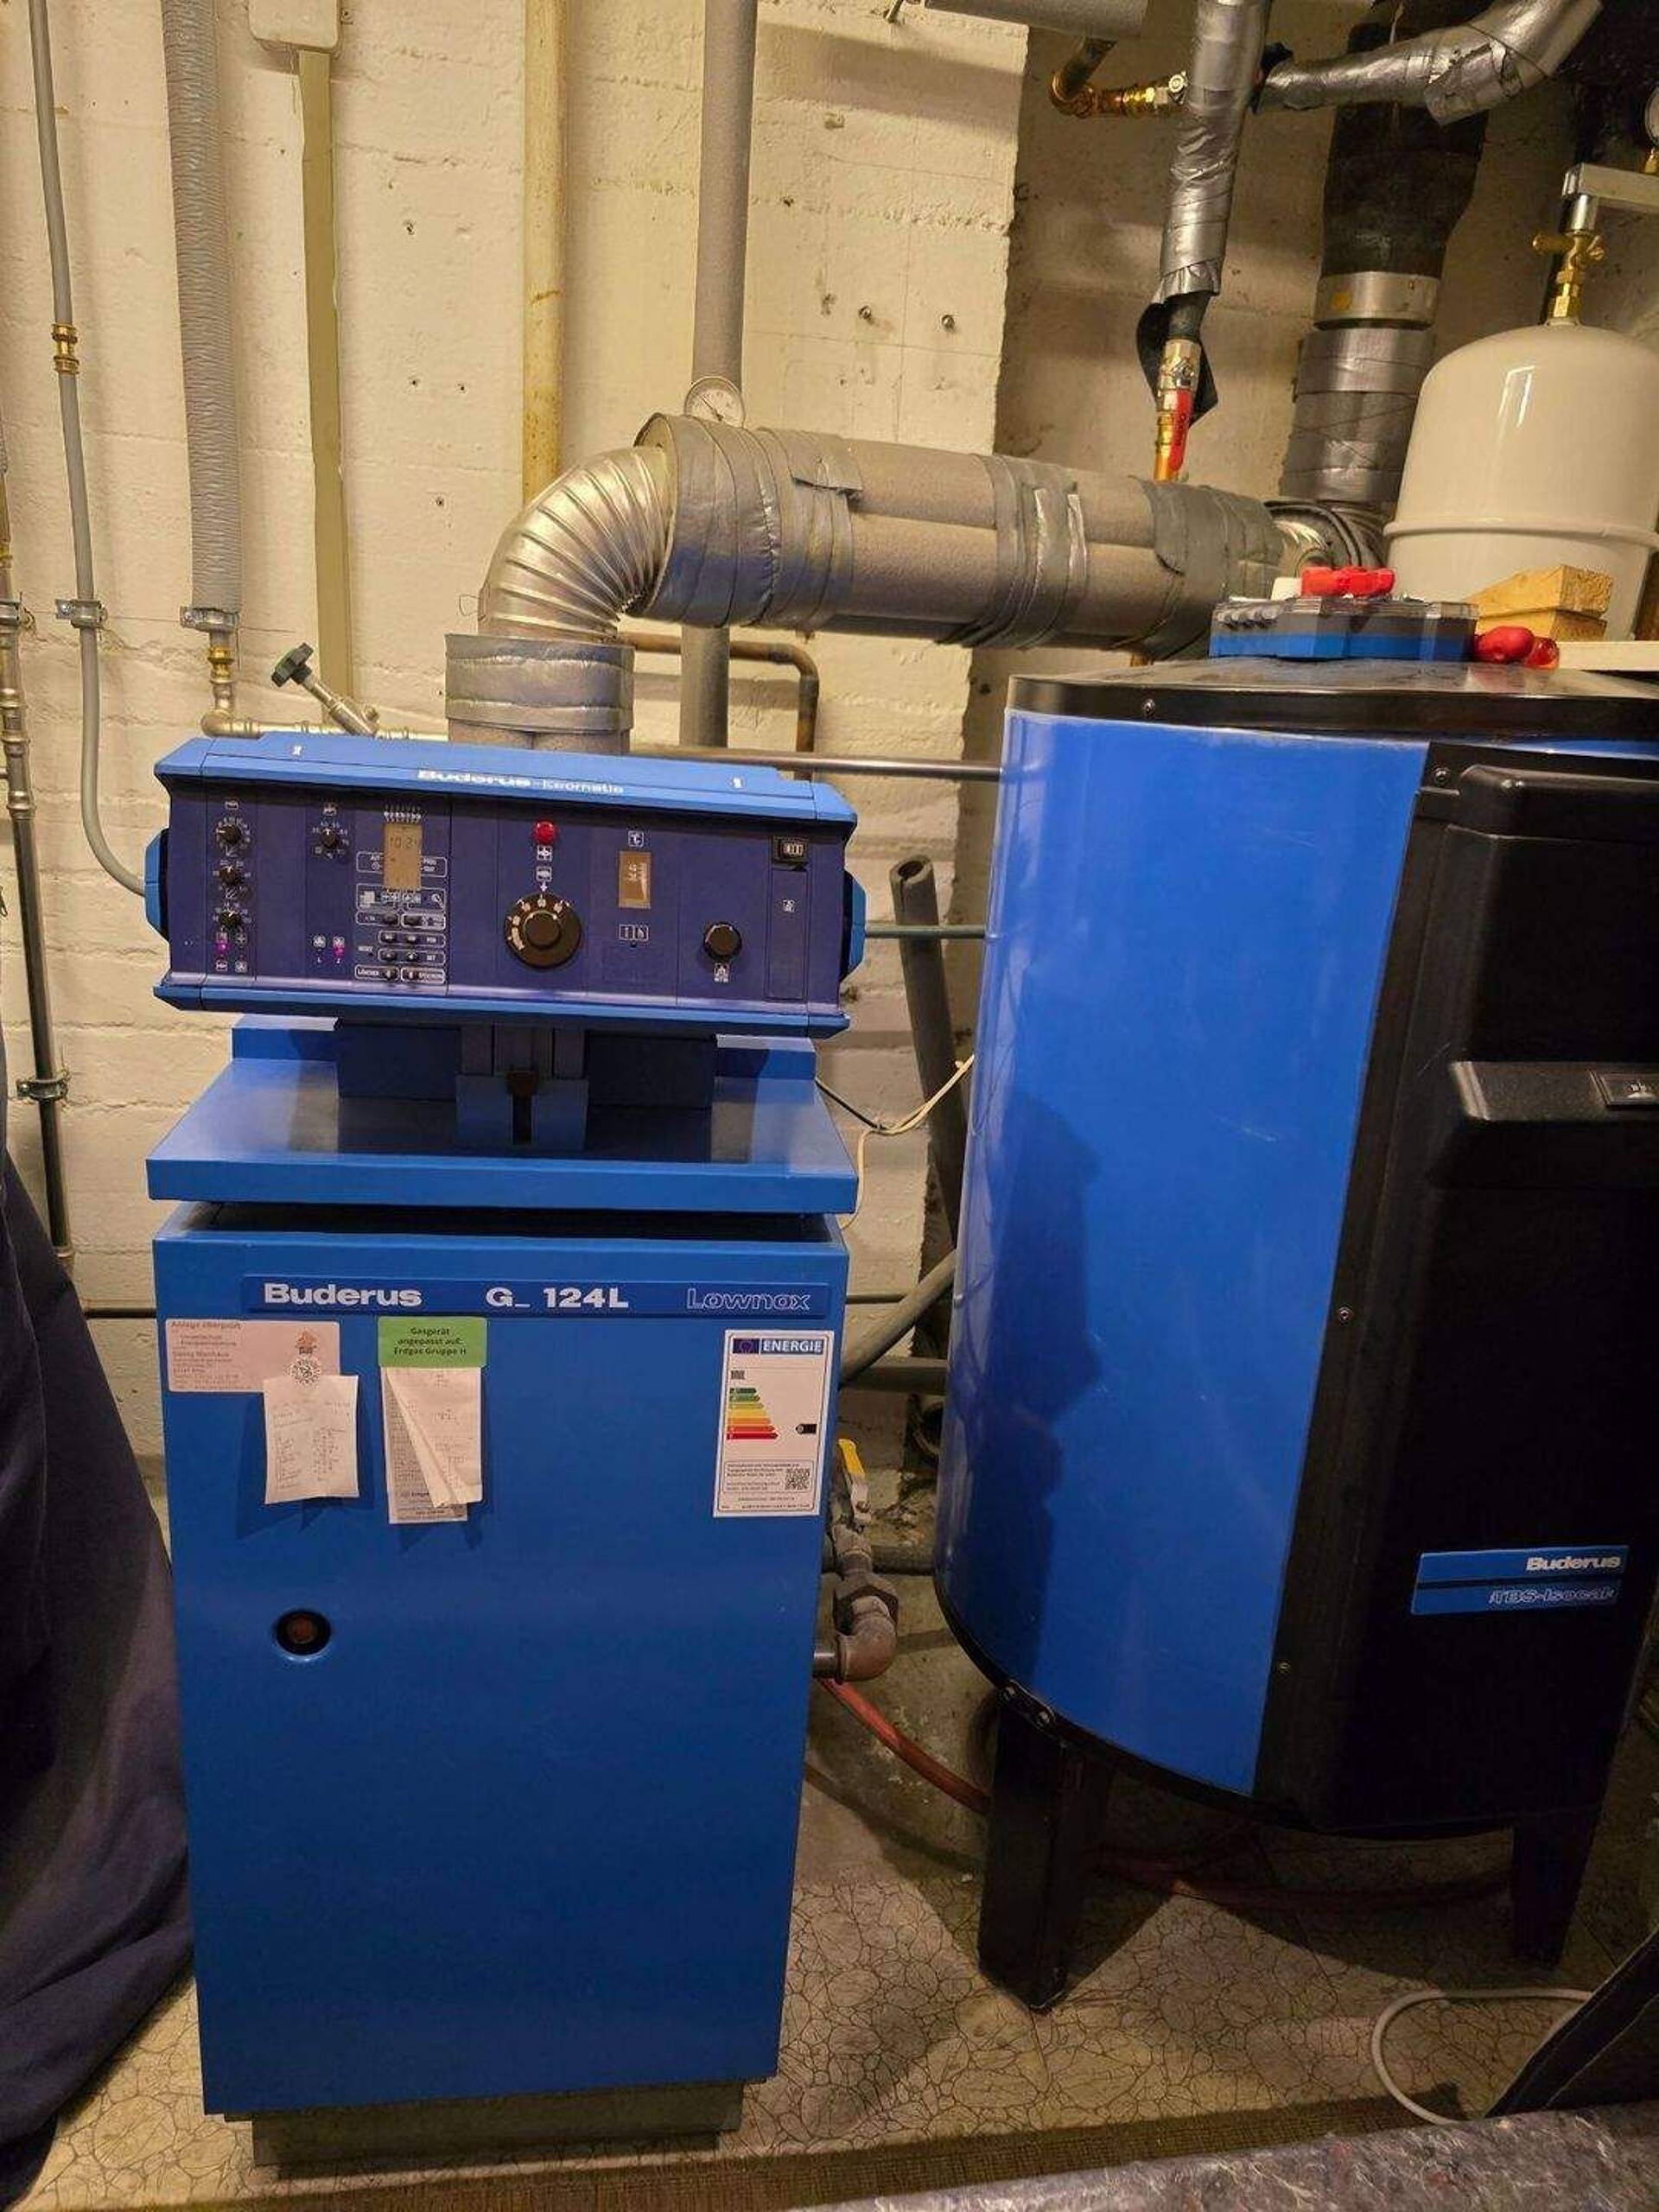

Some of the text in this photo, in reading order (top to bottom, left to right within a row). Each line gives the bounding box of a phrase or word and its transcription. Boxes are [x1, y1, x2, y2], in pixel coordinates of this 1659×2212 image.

[417, 769, 531, 788] Buderus
[264, 1282, 423, 1307] Buderus
[543, 1287, 629, 1308] 124L
[687, 1287, 811, 1311] Lownox
[762, 1340, 823, 1353] ENERGIE
[1526, 1555, 1621, 1571] Buderus
